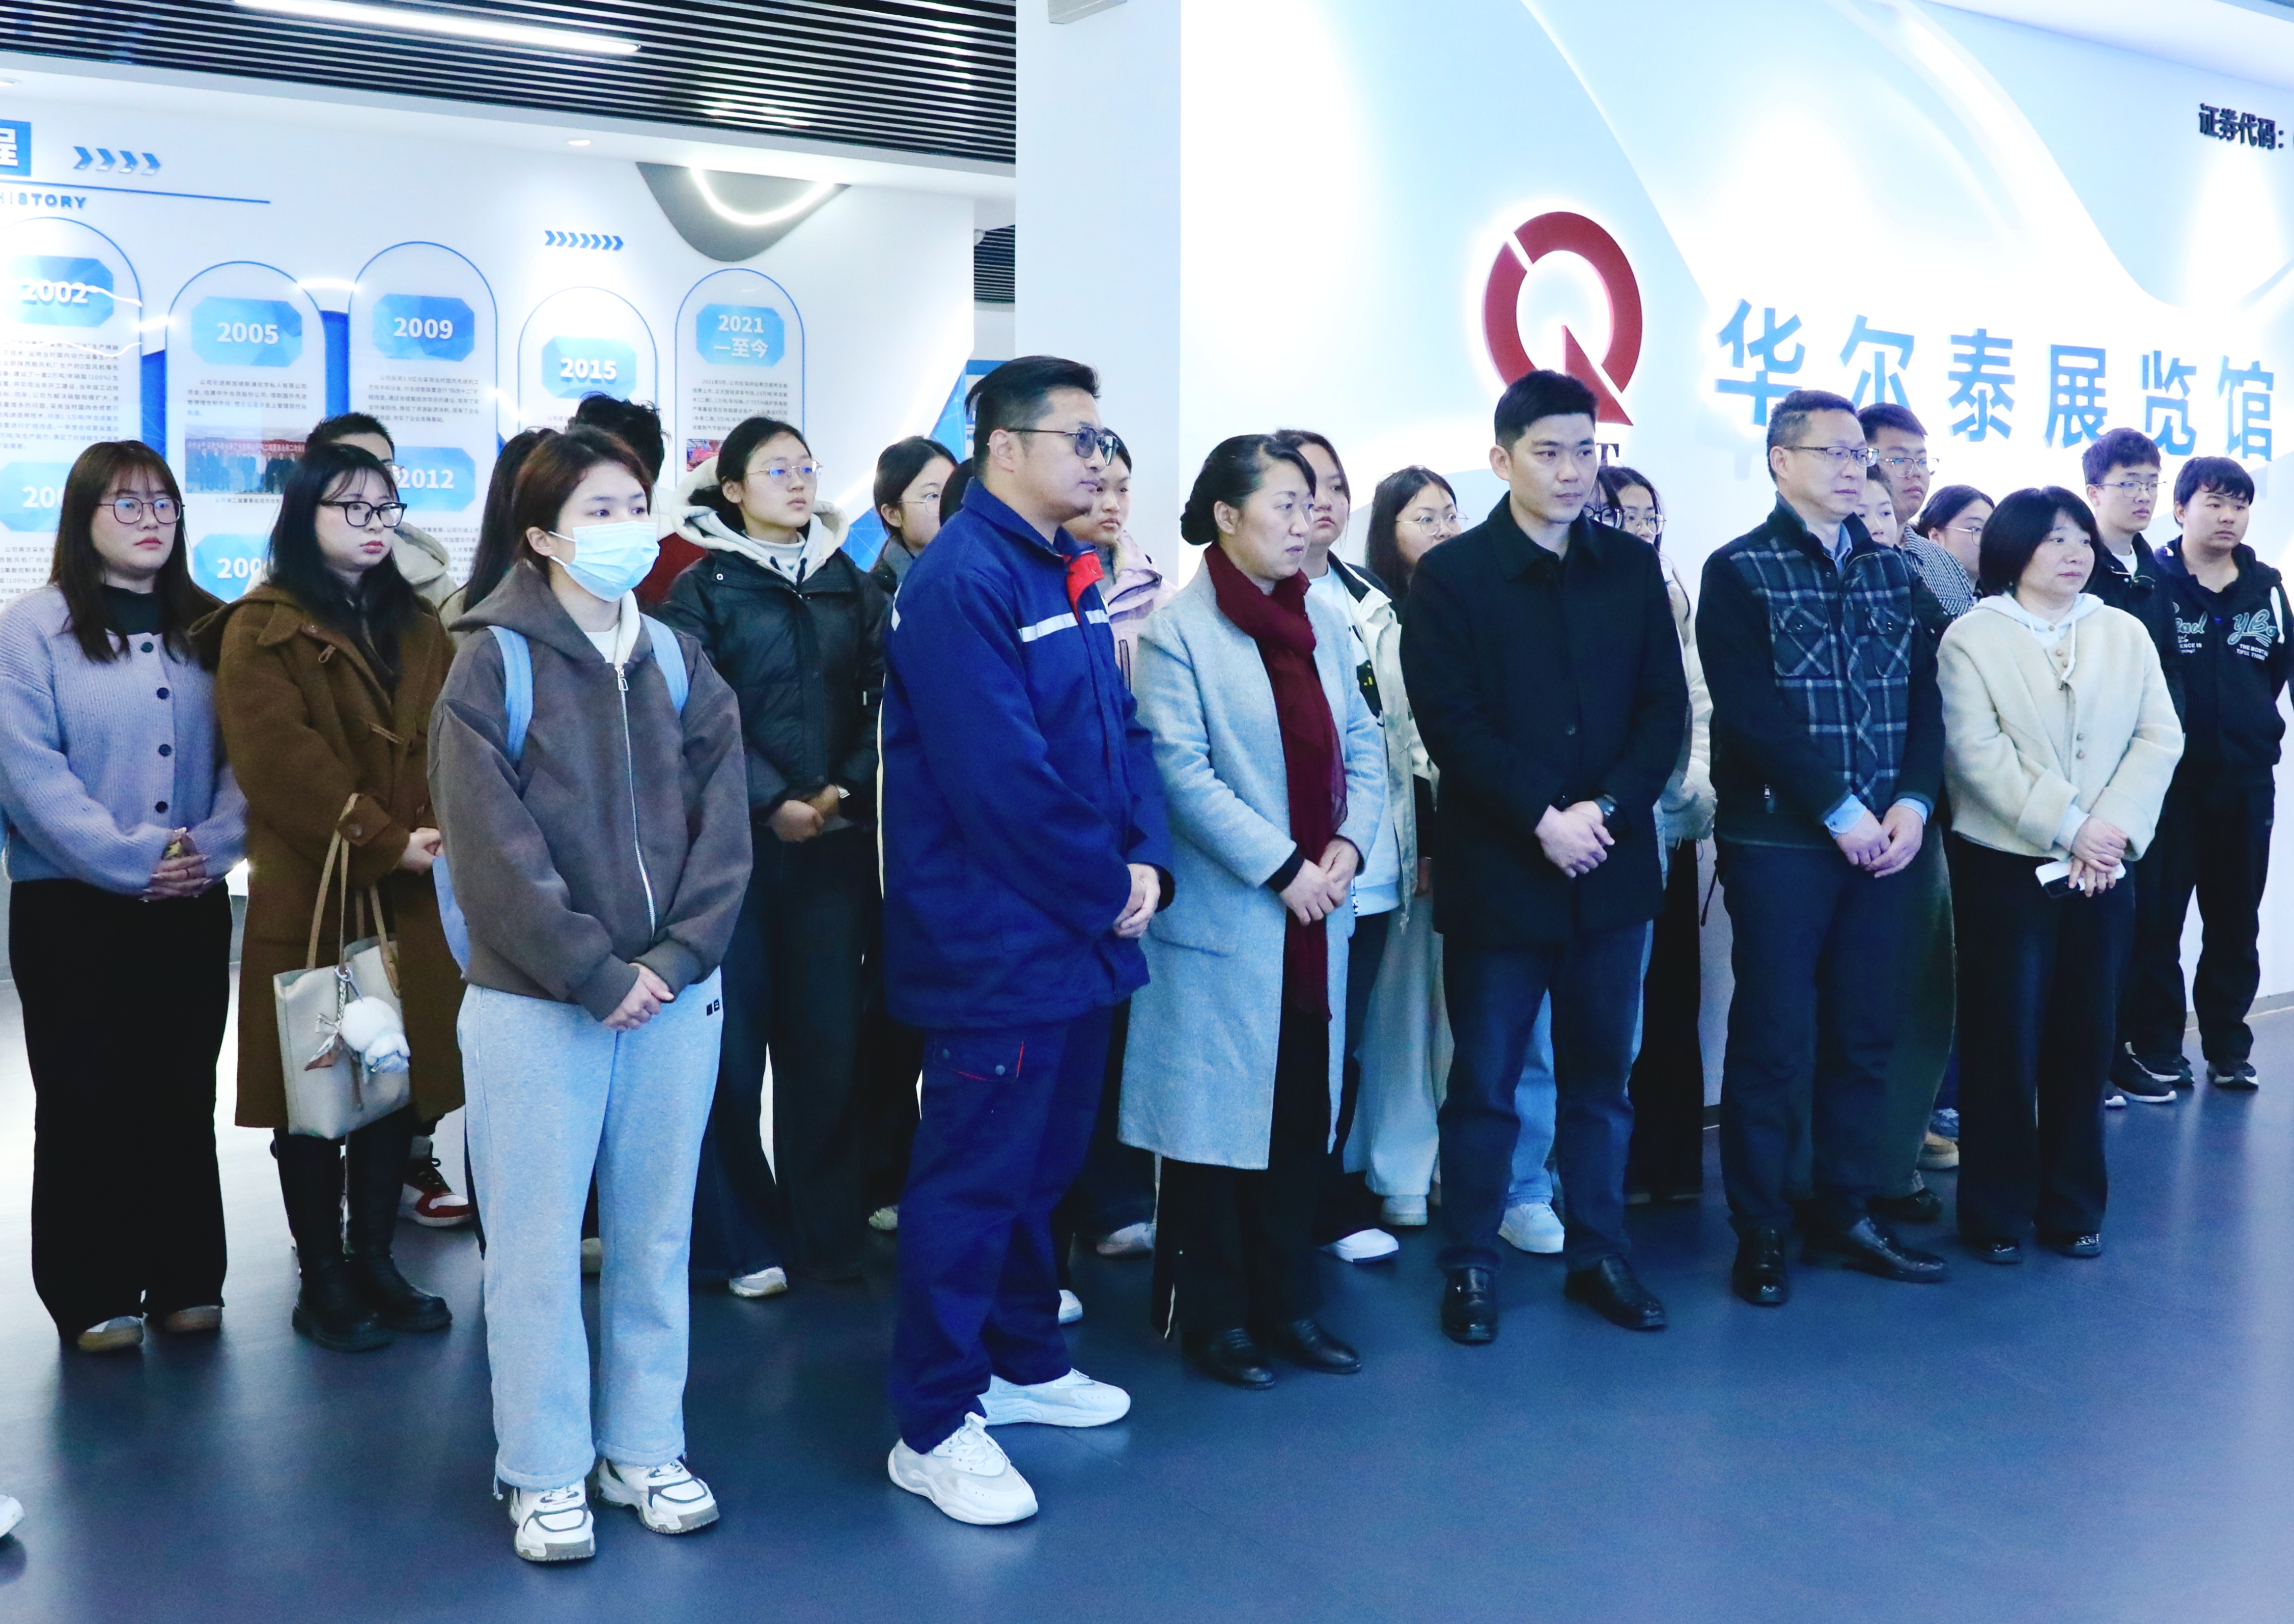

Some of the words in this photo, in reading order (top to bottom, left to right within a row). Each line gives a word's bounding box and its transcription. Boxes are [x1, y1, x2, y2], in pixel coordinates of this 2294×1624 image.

[20, 279, 89, 306] 2002
[216, 322, 279, 345] 2005
[393, 317, 454, 340] 2009
[717, 314, 765, 333] 2021
[560, 358, 618, 383] 2015
[1714, 298, 2275, 462] 华尔泰展览馆
[398, 468, 455, 489] 2012
[22, 486, 64, 508] 20
[217, 557, 262, 578] 200
